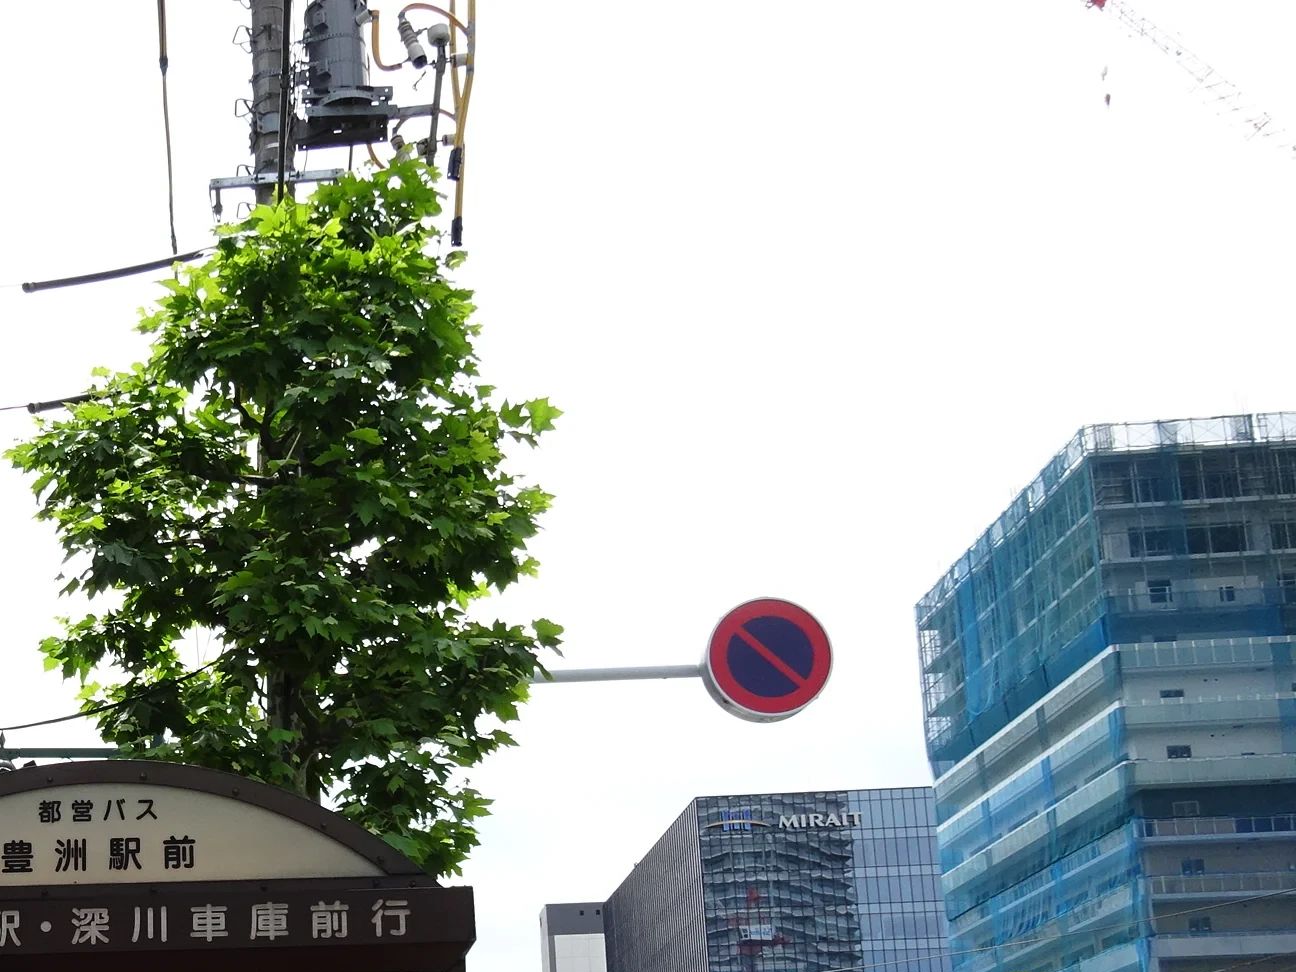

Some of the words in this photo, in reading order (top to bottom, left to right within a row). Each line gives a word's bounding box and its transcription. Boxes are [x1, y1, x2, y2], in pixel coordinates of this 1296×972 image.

[38, 798, 159, 824] 都営バス
[779, 811, 862, 830] MIRAIT
[0, 834, 198, 873] 豊洲駅前
